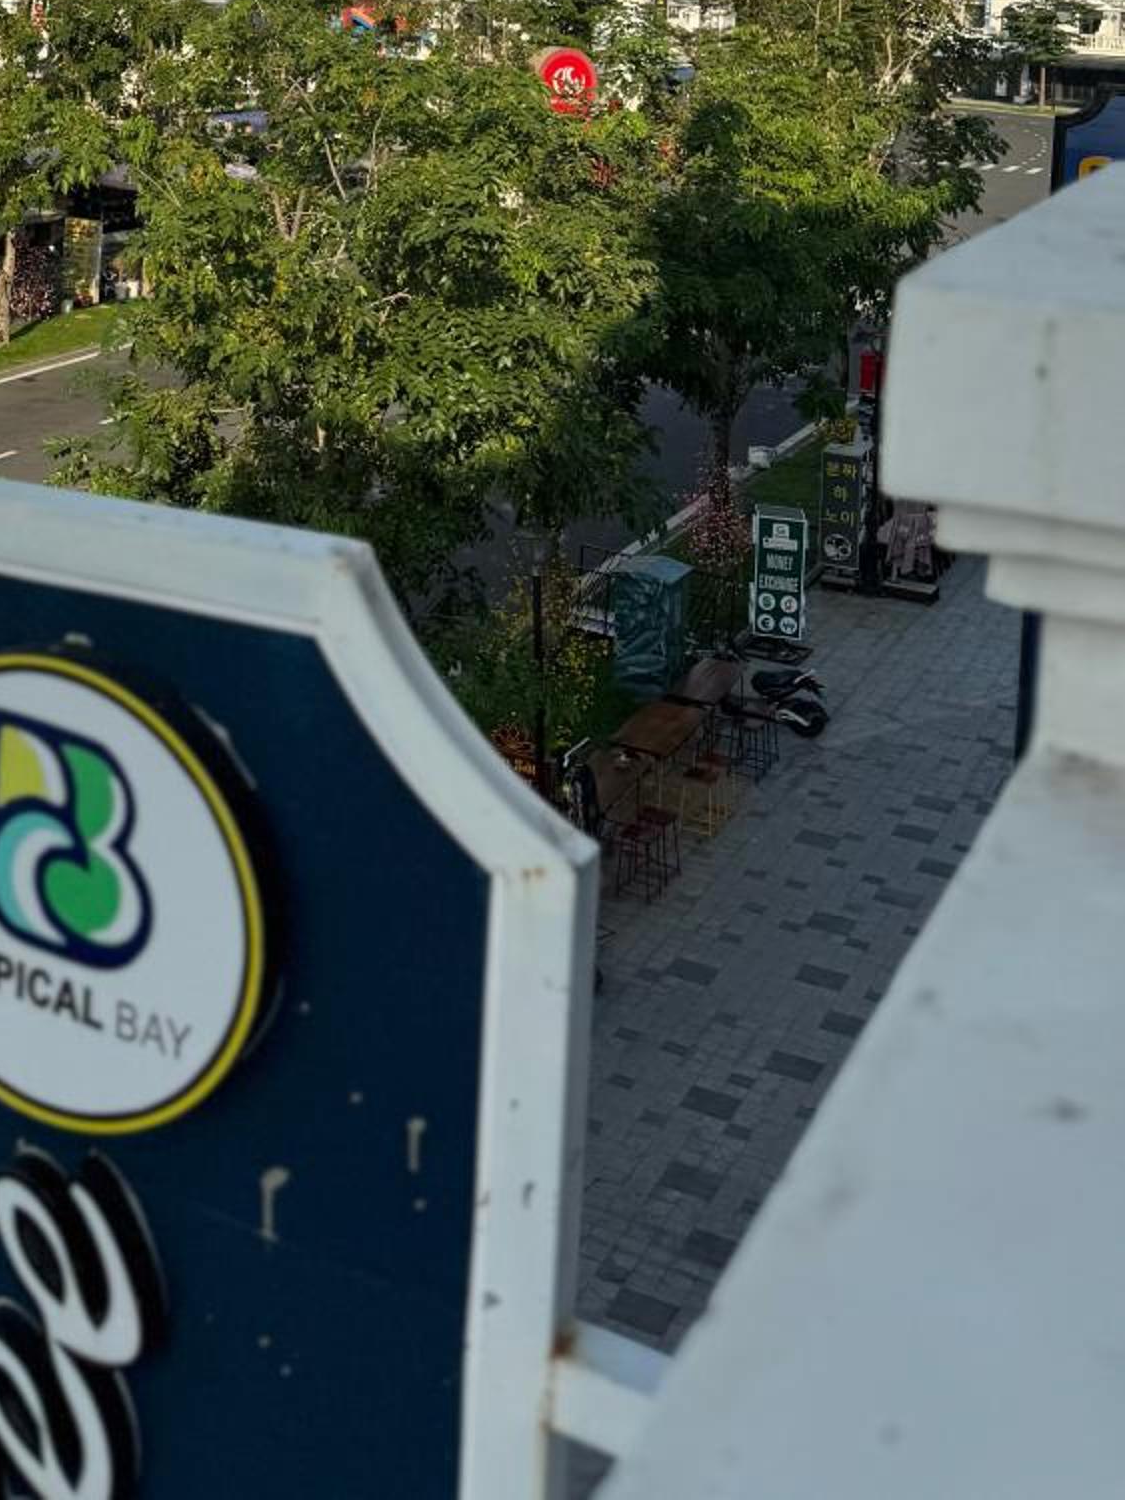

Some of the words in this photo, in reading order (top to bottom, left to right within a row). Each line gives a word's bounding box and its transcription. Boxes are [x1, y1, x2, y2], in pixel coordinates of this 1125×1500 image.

[766, 553, 794, 571] MONEY
[758, 573, 799, 593] EXCHANGE
[114, 1000, 193, 1060] BAY
